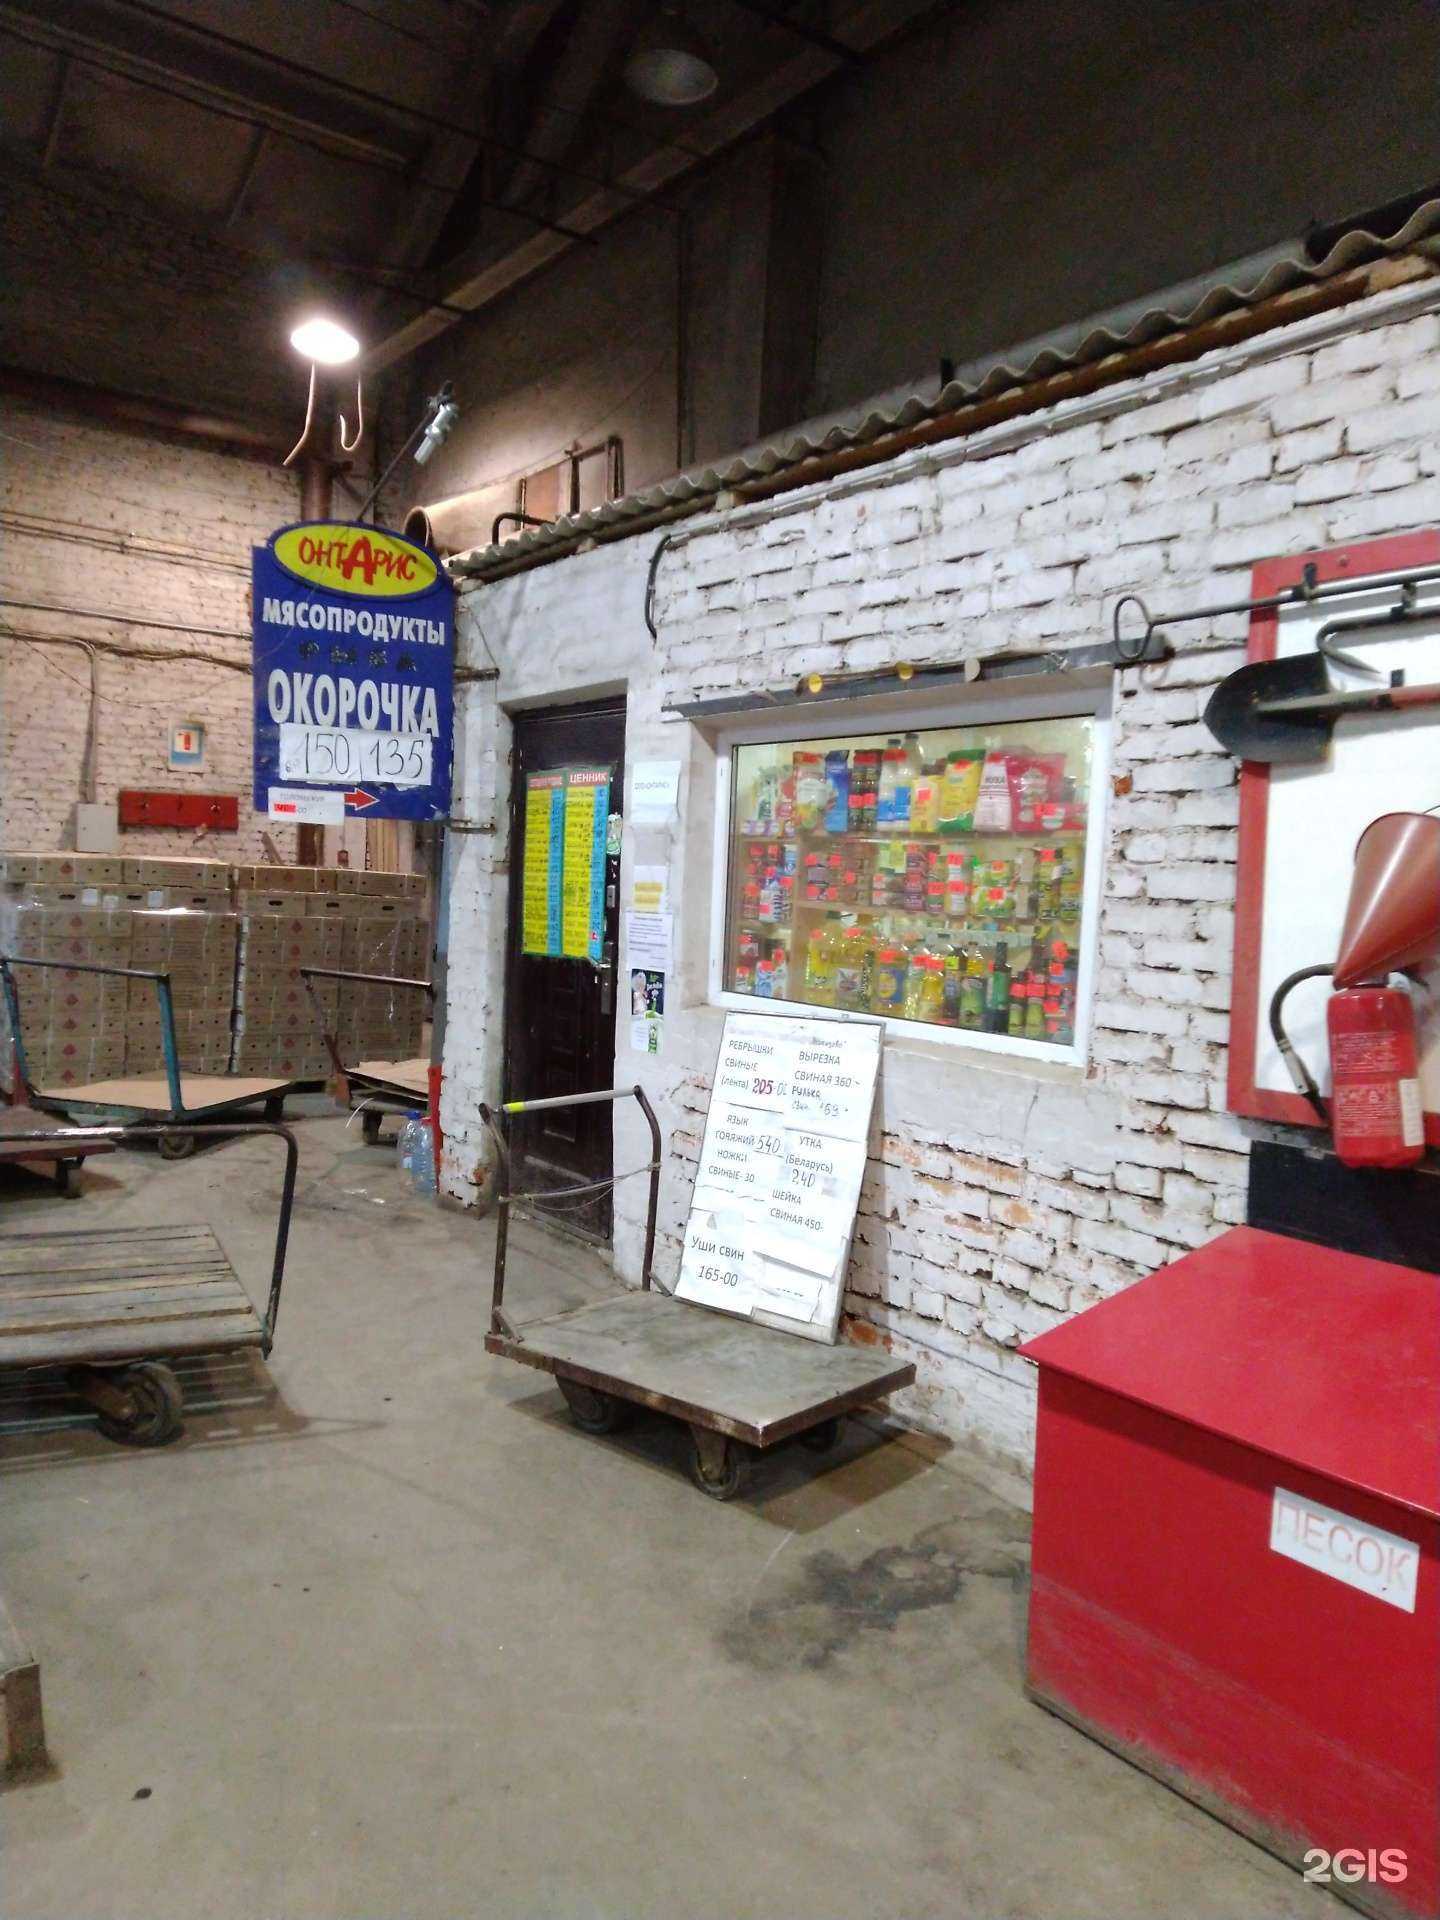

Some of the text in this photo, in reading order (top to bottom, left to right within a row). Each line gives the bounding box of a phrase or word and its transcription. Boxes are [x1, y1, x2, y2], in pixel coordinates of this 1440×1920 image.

[262, 597, 446, 646] МЯСОПРОДУКТЫ
[267, 668, 440, 738] ОКОРОЧКА
[304, 732, 425, 778] 150 135
[569, 771, 608, 784] ЦЕННИК
[728, 1039, 774, 1056] РЕБРЫШКИ
[724, 1056, 760, 1072] СВИНЫЕ
[798, 1050, 841, 1066] ВЫРЕЗКА
[794, 1070, 833, 1085] СВИНАЯ
[726, 1114, 750, 1127] ЯЗЫК
[755, 1135, 781, 1154] 540
[799, 1135, 822, 1150] УТКА
[785, 1154, 834, 1175] (Беларусь)
[772, 1188, 802, 1205] ШЕЙКА
[769, 1207, 804, 1226] СВИНАЯ
[697, 1265, 738, 1288] 165-00
[1277, 1501, 1411, 1591] ПЕСОК
